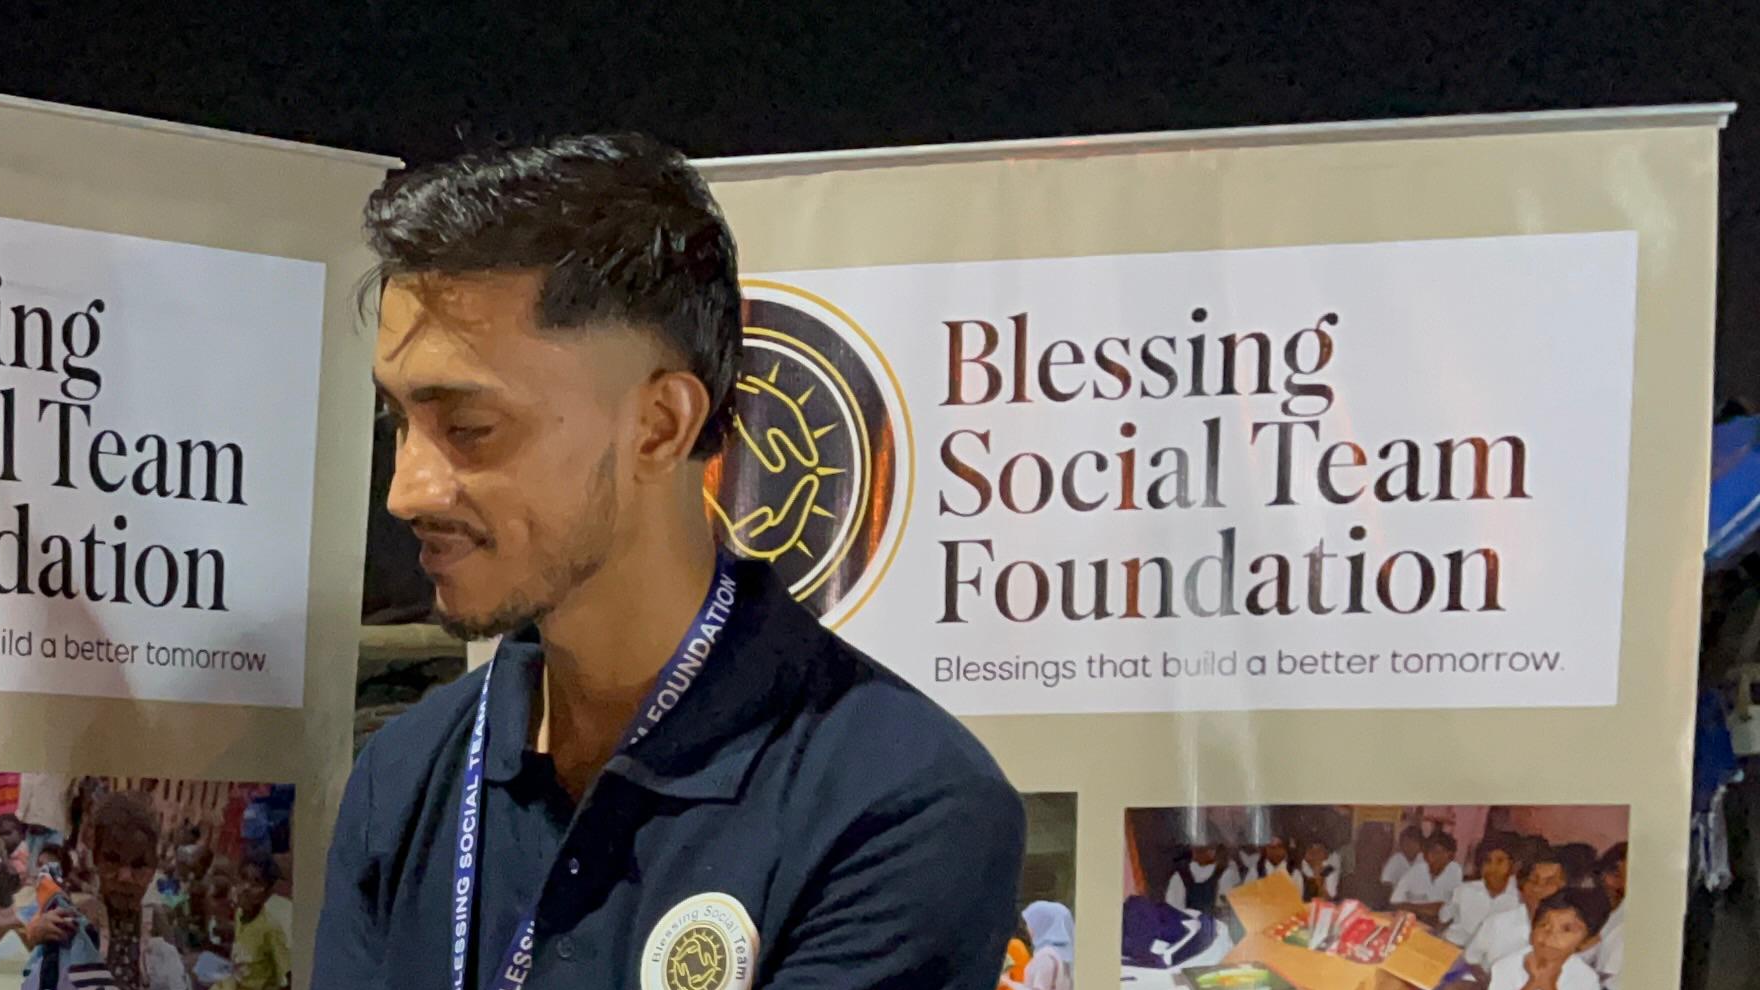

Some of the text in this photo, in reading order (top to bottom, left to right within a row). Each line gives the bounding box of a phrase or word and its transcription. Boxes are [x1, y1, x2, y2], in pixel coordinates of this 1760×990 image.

[938, 307, 1340, 418] Blessing
[38, 398, 248, 506] Team
[938, 416, 1534, 518] Social Team
[935, 525, 1507, 625] Foundation
[40, 637, 57, 659] a
[64, 634, 139, 664] better
[646, 573, 738, 723] FOUNDATION
[934, 649, 1566, 688] Blessings that build a better tomorrow.
[459, 773, 480, 869] SOCIAL
[651, 905, 748, 981] Blessing Social Team
